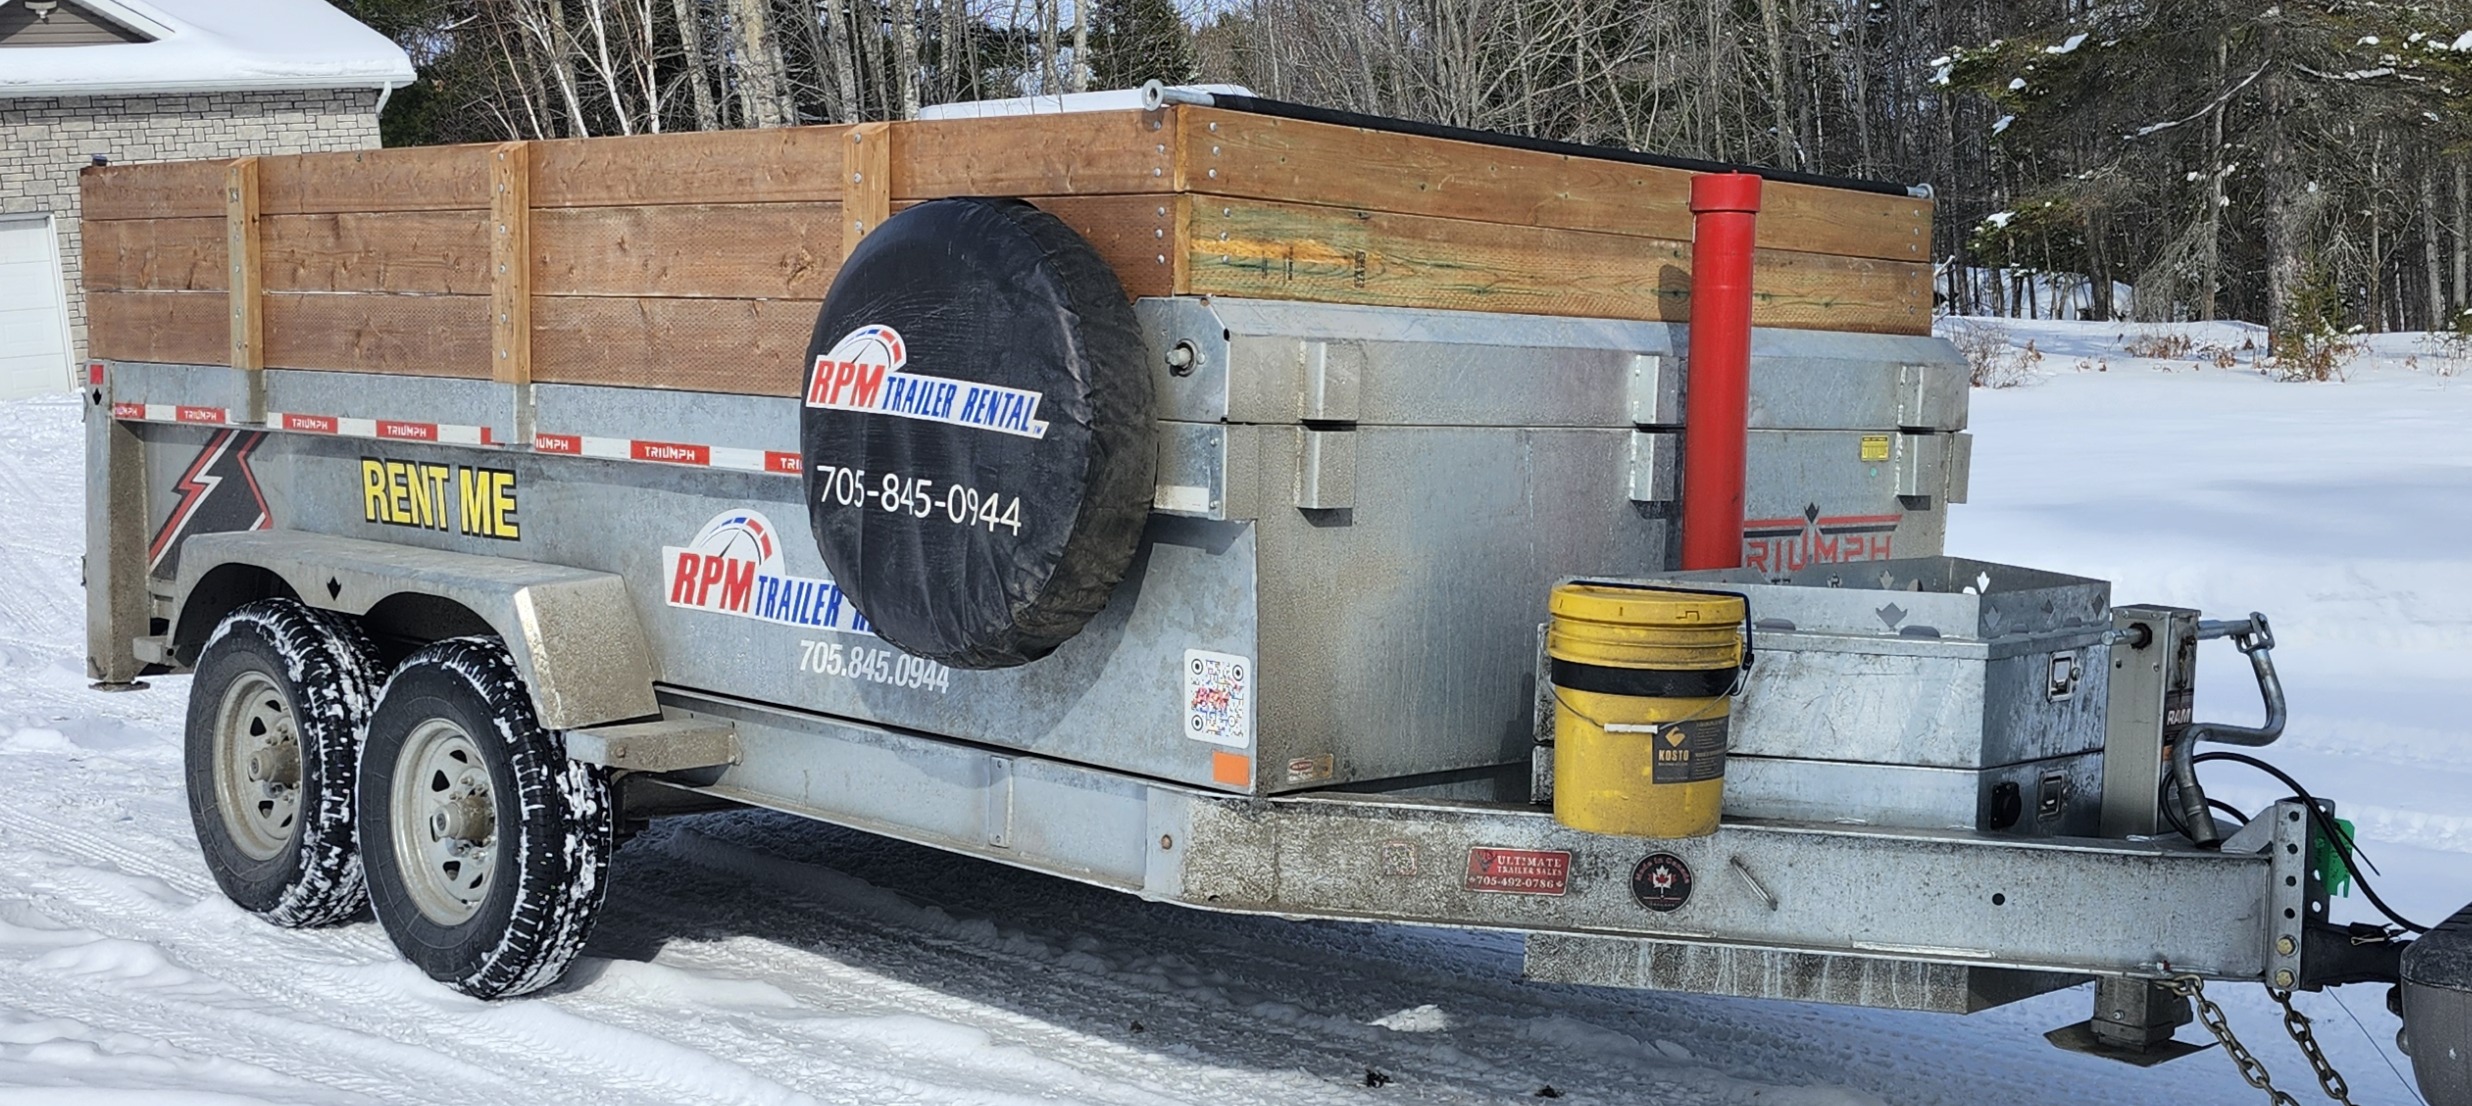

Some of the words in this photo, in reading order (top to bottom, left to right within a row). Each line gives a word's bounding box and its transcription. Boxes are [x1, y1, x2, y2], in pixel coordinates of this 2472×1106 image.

[809, 361, 885, 408] RPM
[882, 376, 957, 419] TRAILER
[960, 387, 1035, 432] RENTAL
[184, 410, 217, 421] TRIUMPH
[292, 418, 329, 431] TRIUMPH
[386, 425, 427, 437] TRIUMPH
[536, 436, 569, 450] IUMPH
[645, 446, 696, 461] TRIUMPH
[361, 457, 449, 531] RENT
[459, 466, 520, 541] ME
[817, 465, 1022, 537] 705-845-0944
[1746, 527, 1893, 573] RIUMPH
[670, 552, 756, 613] RPM
[755, 575, 843, 628] TRAILER
[800, 640, 950, 694] 705.845.0944
[2166, 708, 2192, 726] RAM
[1658, 749, 1690, 761] KOSTO
[1497, 855, 1562, 868] ULTIMATE
